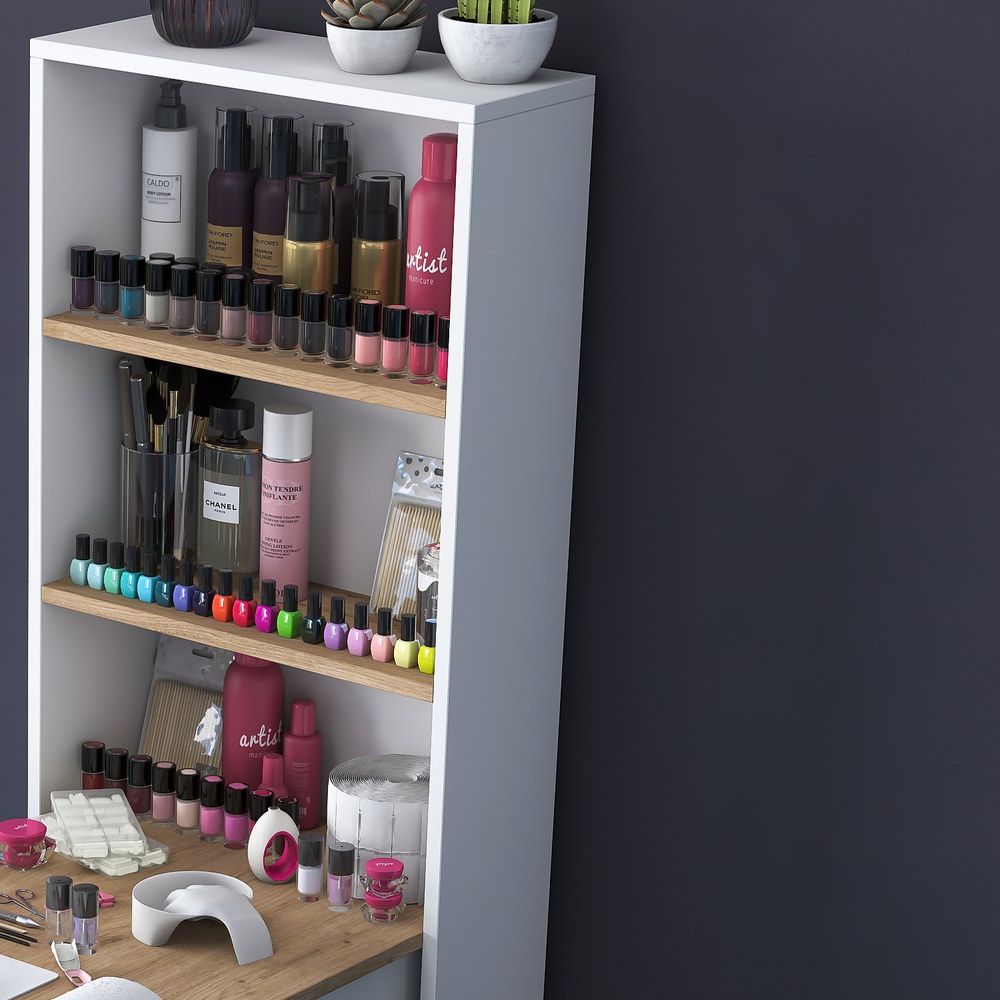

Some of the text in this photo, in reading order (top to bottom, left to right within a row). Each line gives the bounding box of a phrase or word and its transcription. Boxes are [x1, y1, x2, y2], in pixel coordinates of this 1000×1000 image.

[147, 178, 170, 188] CALDO
[260, 239, 279, 247] FORD
[274, 485, 304, 493] TENDRE
[205, 499, 238, 511] CHANEL
[239, 720, 283, 748] artist
